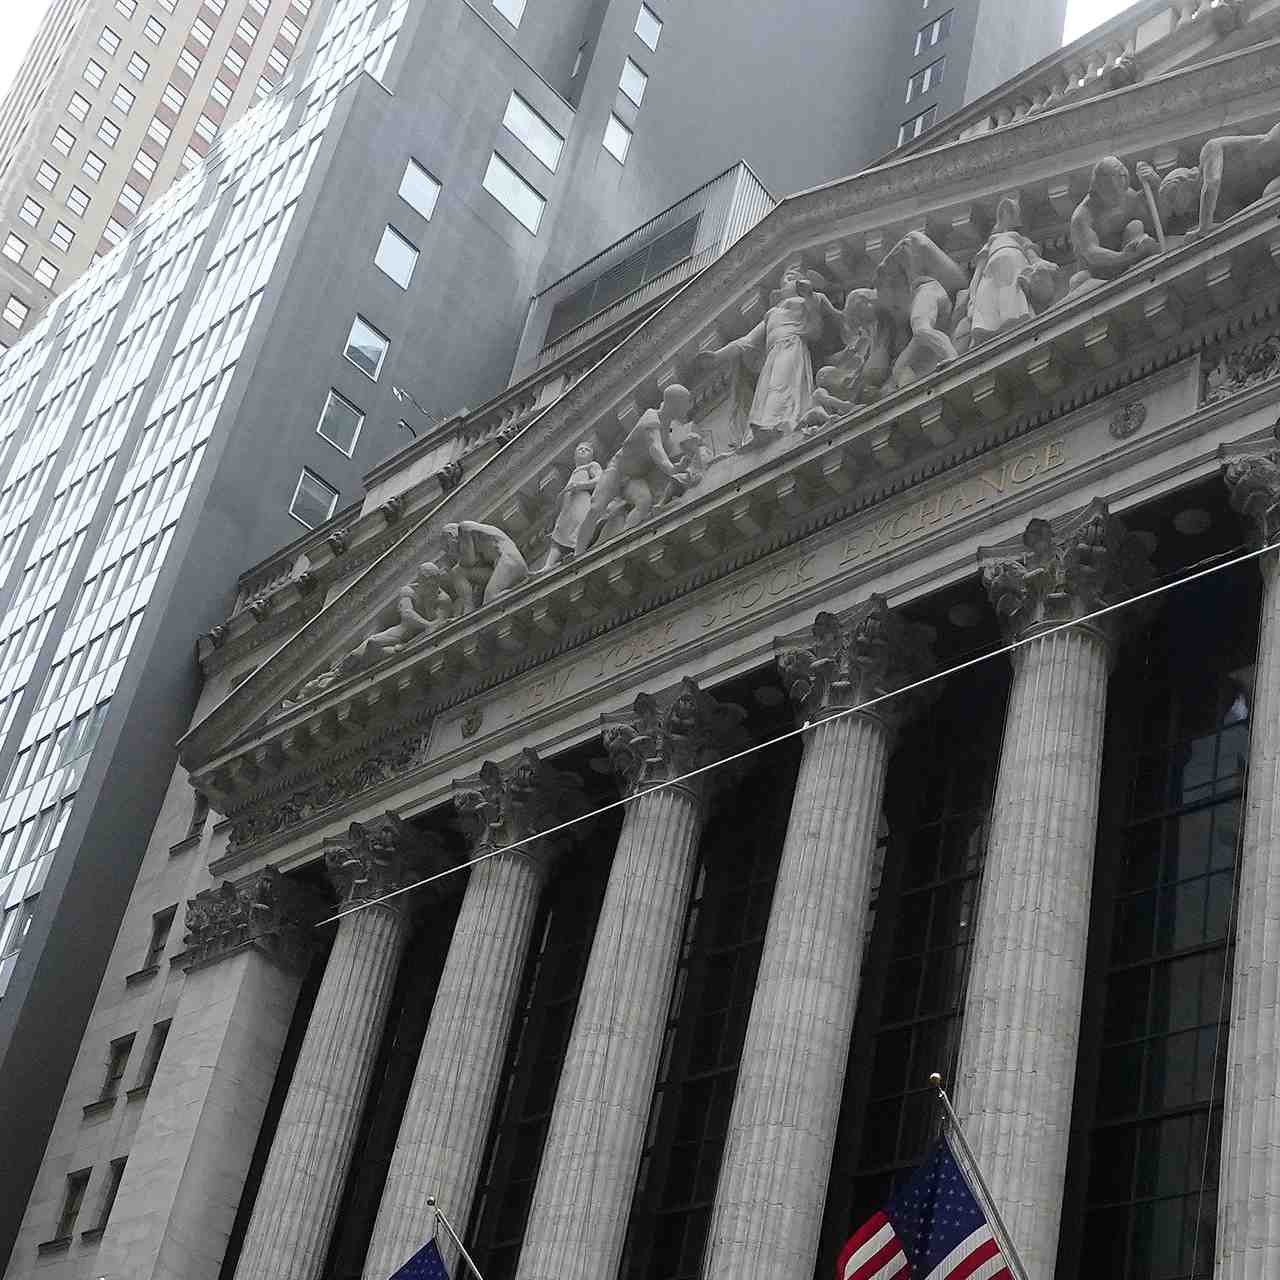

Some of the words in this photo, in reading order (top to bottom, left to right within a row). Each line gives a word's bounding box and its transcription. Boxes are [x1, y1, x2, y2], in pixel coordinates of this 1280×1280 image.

[504, 665, 576, 720] NEW
[590, 618, 677, 679] YORK
[699, 552, 817, 629] STOCK
[839, 438, 1067, 566] EXCHANGE
